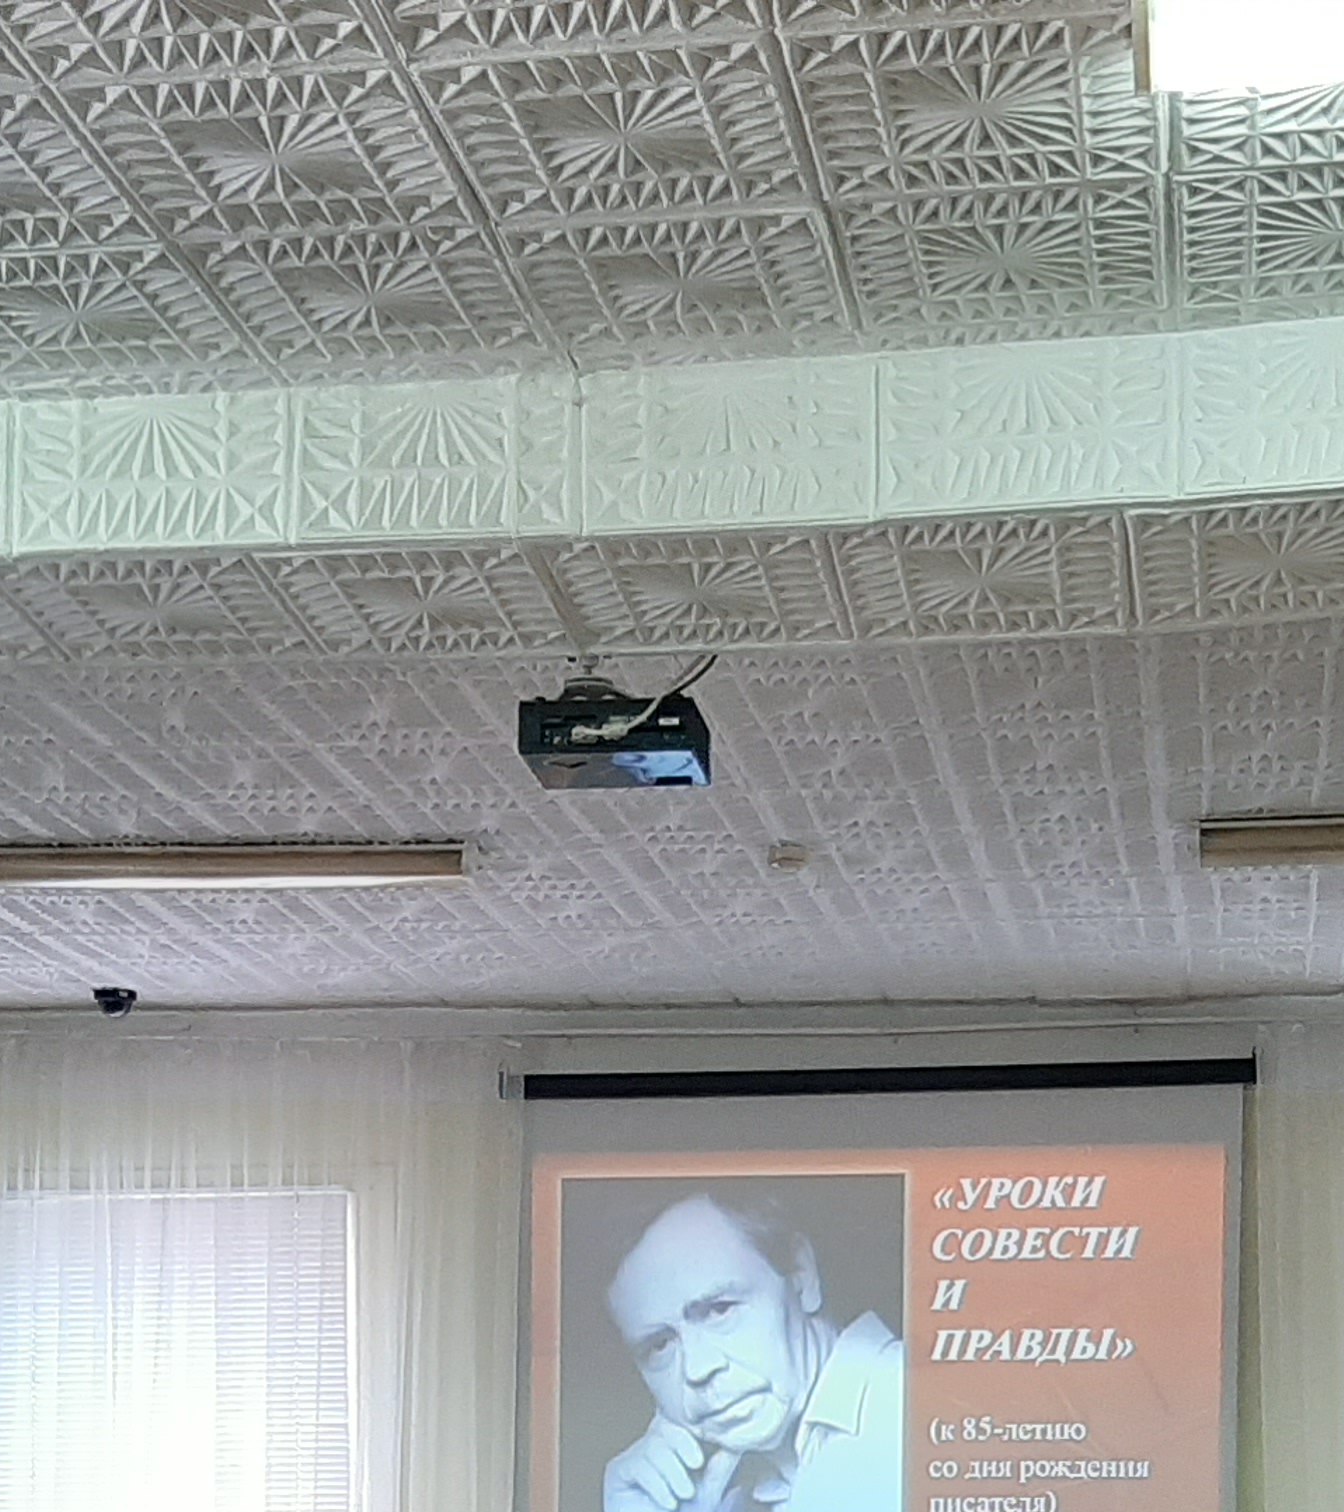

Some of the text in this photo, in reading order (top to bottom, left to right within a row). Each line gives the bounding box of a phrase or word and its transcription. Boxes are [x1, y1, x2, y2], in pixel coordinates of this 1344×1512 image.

[932, 1174, 1106, 1211] «УРОКИ
[931, 1225, 1140, 1262] СОВЕСТИ
[930, 1277, 968, 1312] И
[930, 1327, 1136, 1368] ПРАВДЫ»
[929, 1416, 1087, 1445] (к 85-летию
[928, 1459, 1150, 1484] со дня рождения
